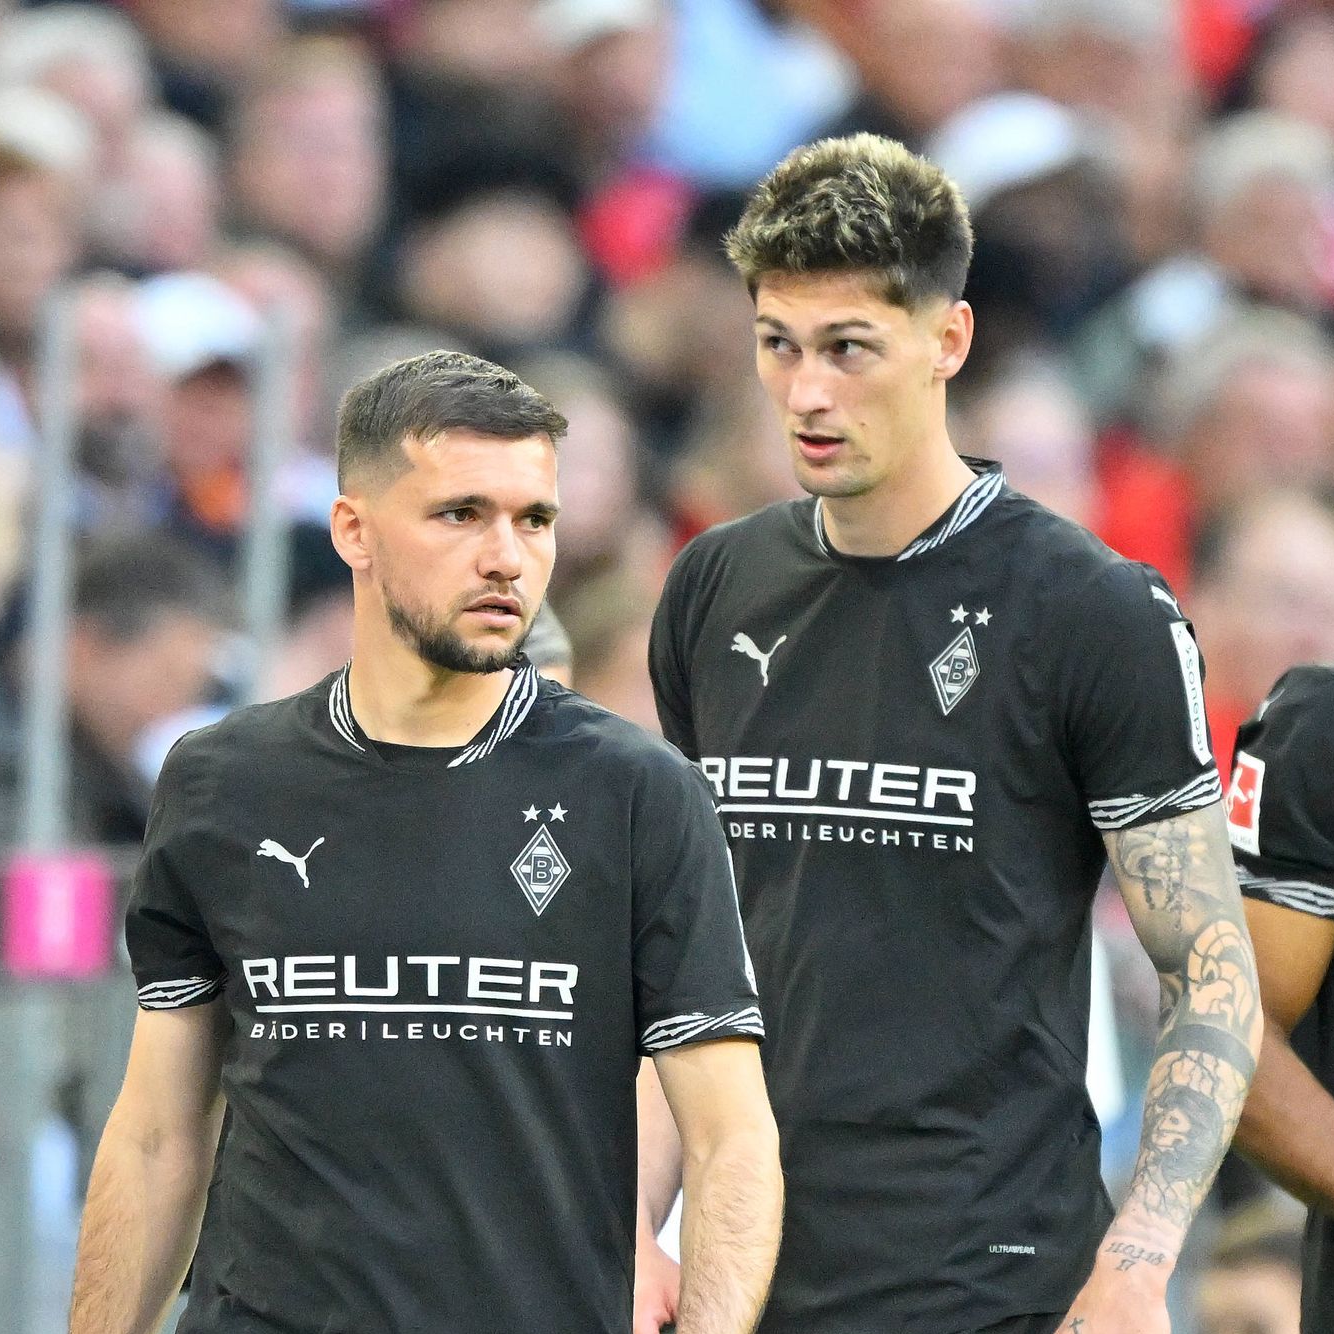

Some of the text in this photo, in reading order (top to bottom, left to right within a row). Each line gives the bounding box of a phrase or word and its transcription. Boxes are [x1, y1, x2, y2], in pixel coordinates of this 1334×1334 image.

[700, 756, 977, 812] REUTER
[729, 821, 974, 853] DER LEUCHTEN
[242, 955, 579, 1005] REUTER
[249, 1020, 573, 1048] BÄDER LEUCHTEN
